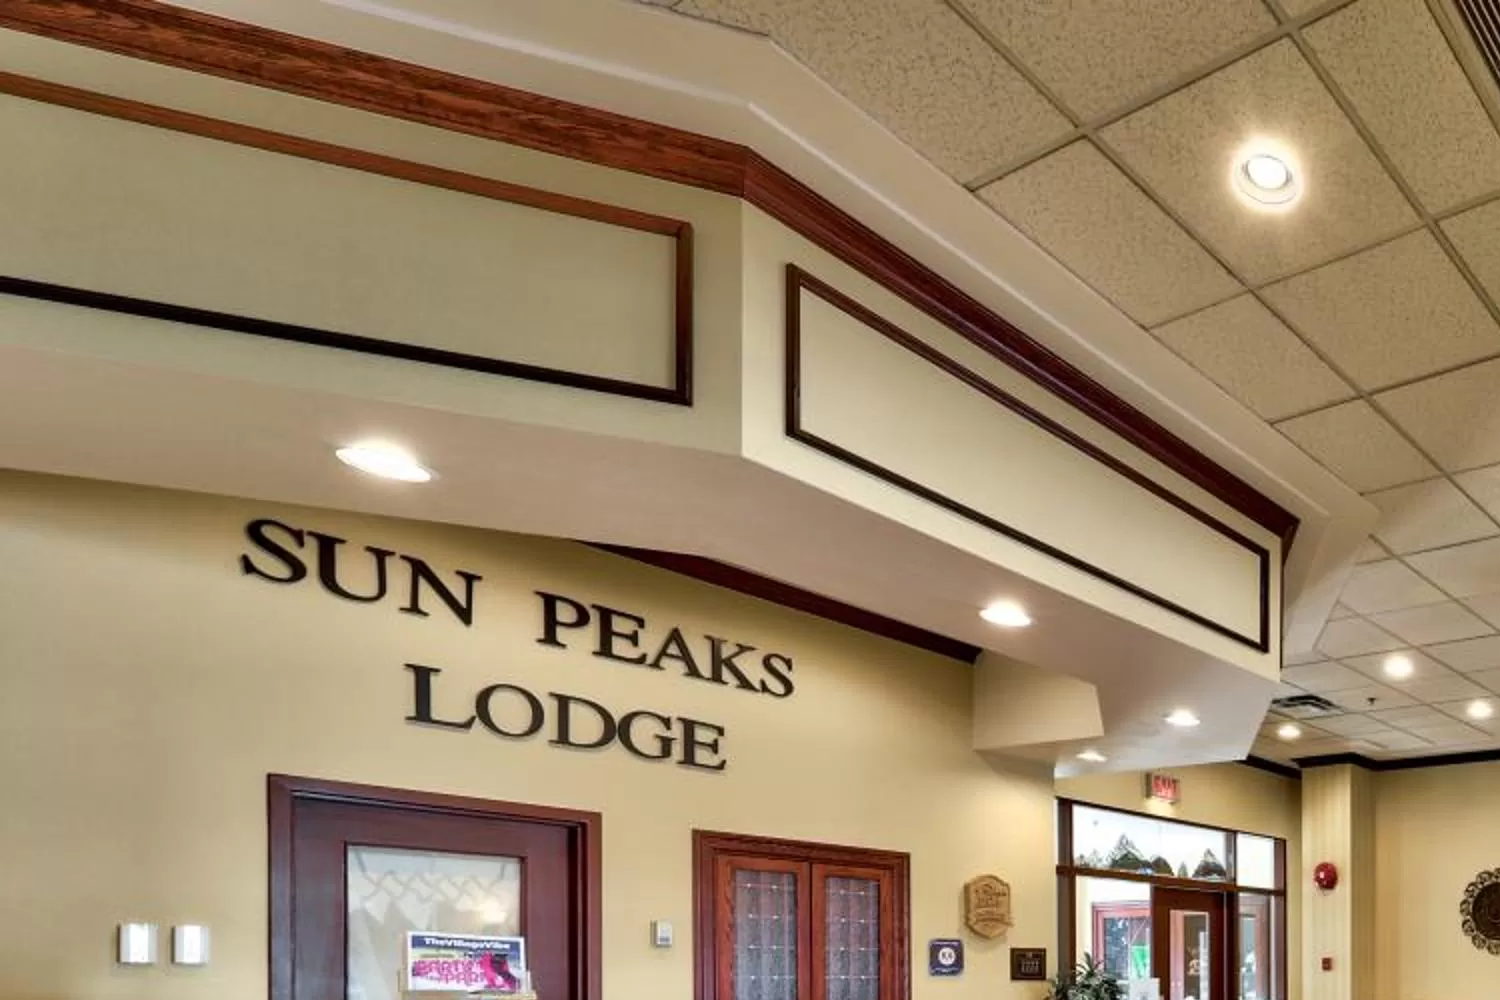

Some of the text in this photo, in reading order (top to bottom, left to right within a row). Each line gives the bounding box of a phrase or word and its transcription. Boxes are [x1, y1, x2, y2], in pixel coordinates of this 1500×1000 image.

[239, 518, 795, 699] SUN PEAKS
[403, 663, 727, 772] LODGE
